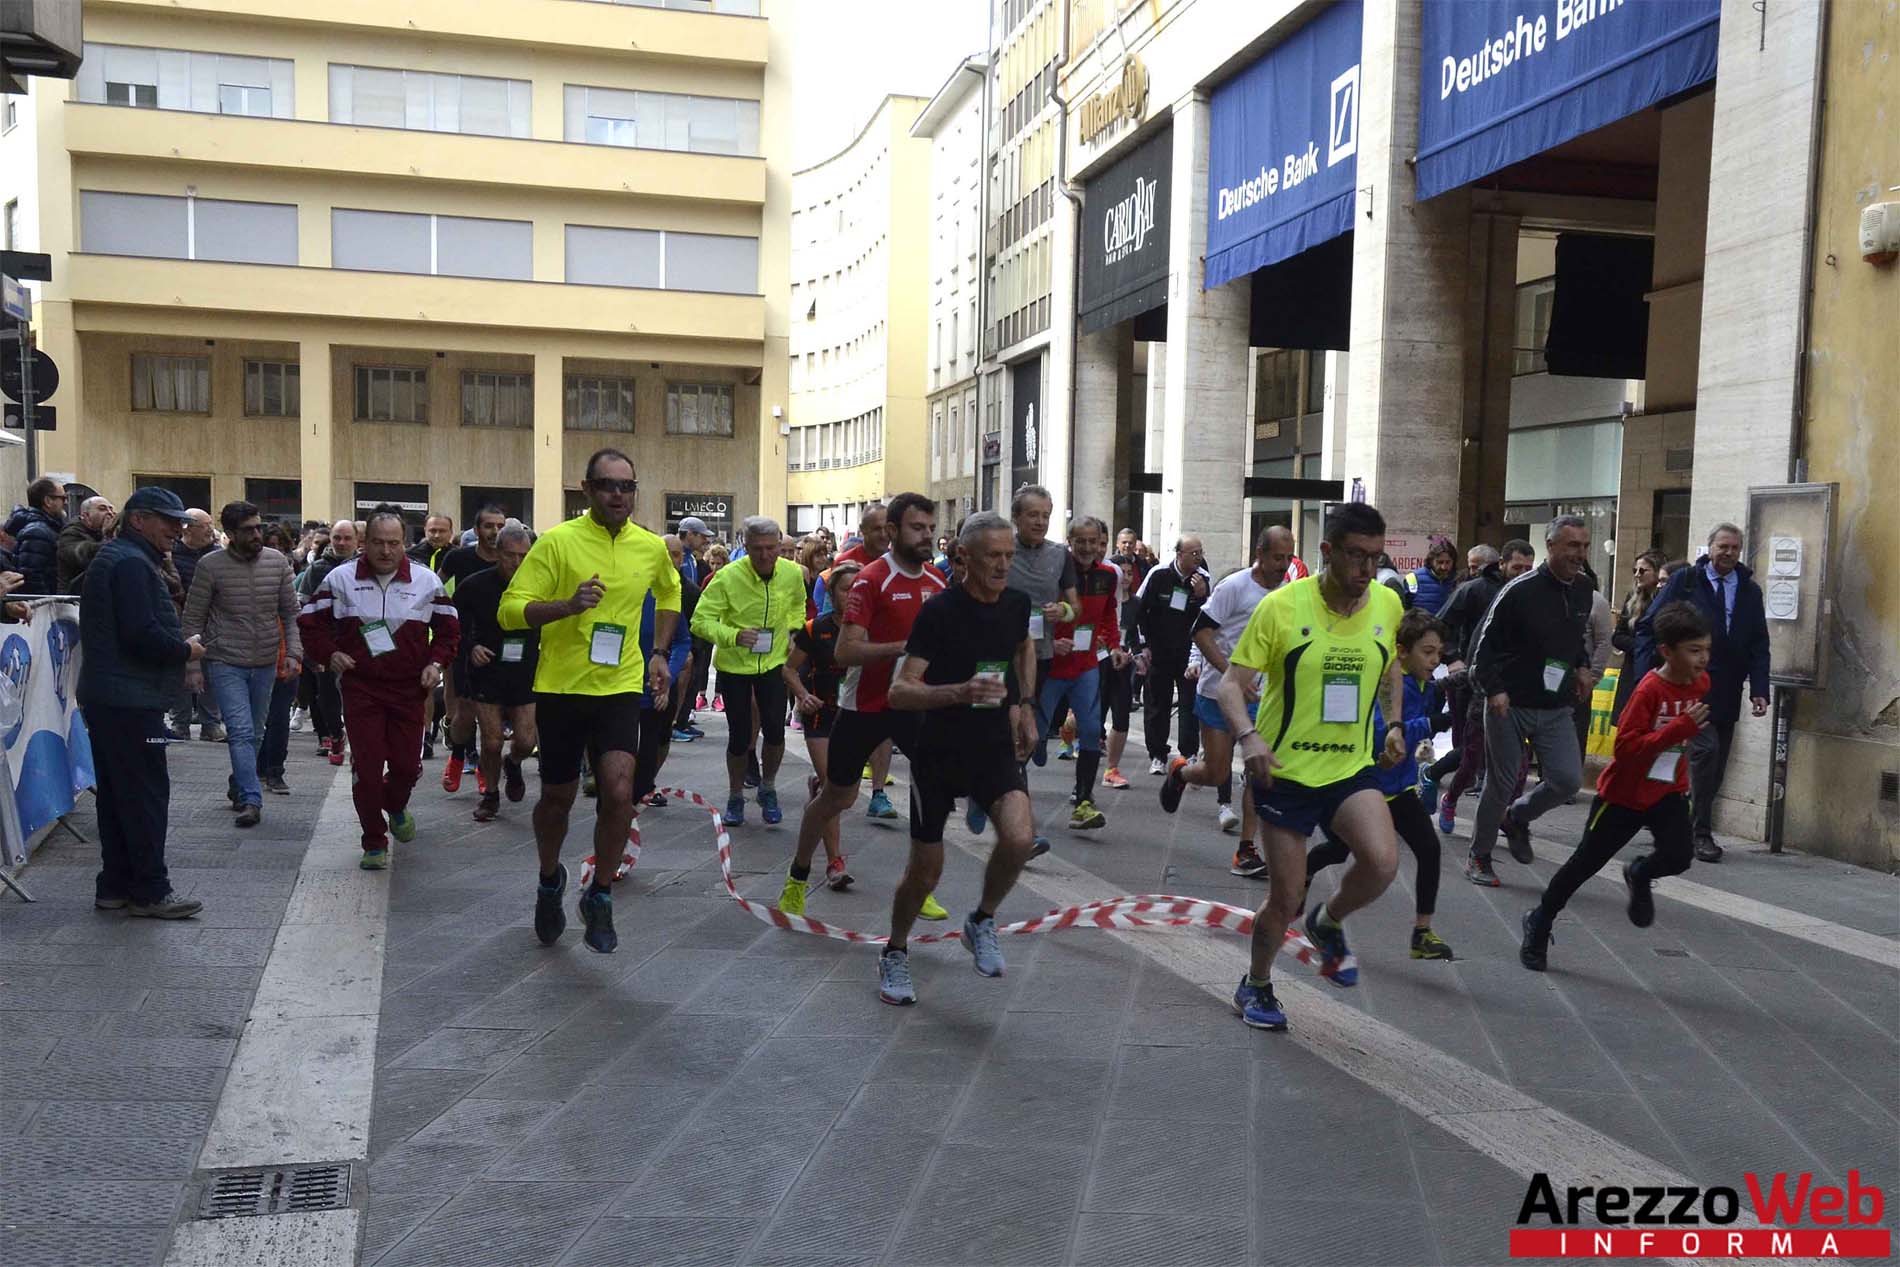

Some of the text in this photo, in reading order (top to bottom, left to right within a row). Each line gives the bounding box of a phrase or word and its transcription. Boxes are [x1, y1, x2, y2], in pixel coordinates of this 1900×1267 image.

[1440, 0, 1624, 101] Deutsche Ban
[1080, 84, 1122, 145] Allianz
[1218, 141, 1320, 220] Deutsche Bank
[1391, 557, 1423, 571] ARDEN
[1324, 655, 1365, 664] gruppo
